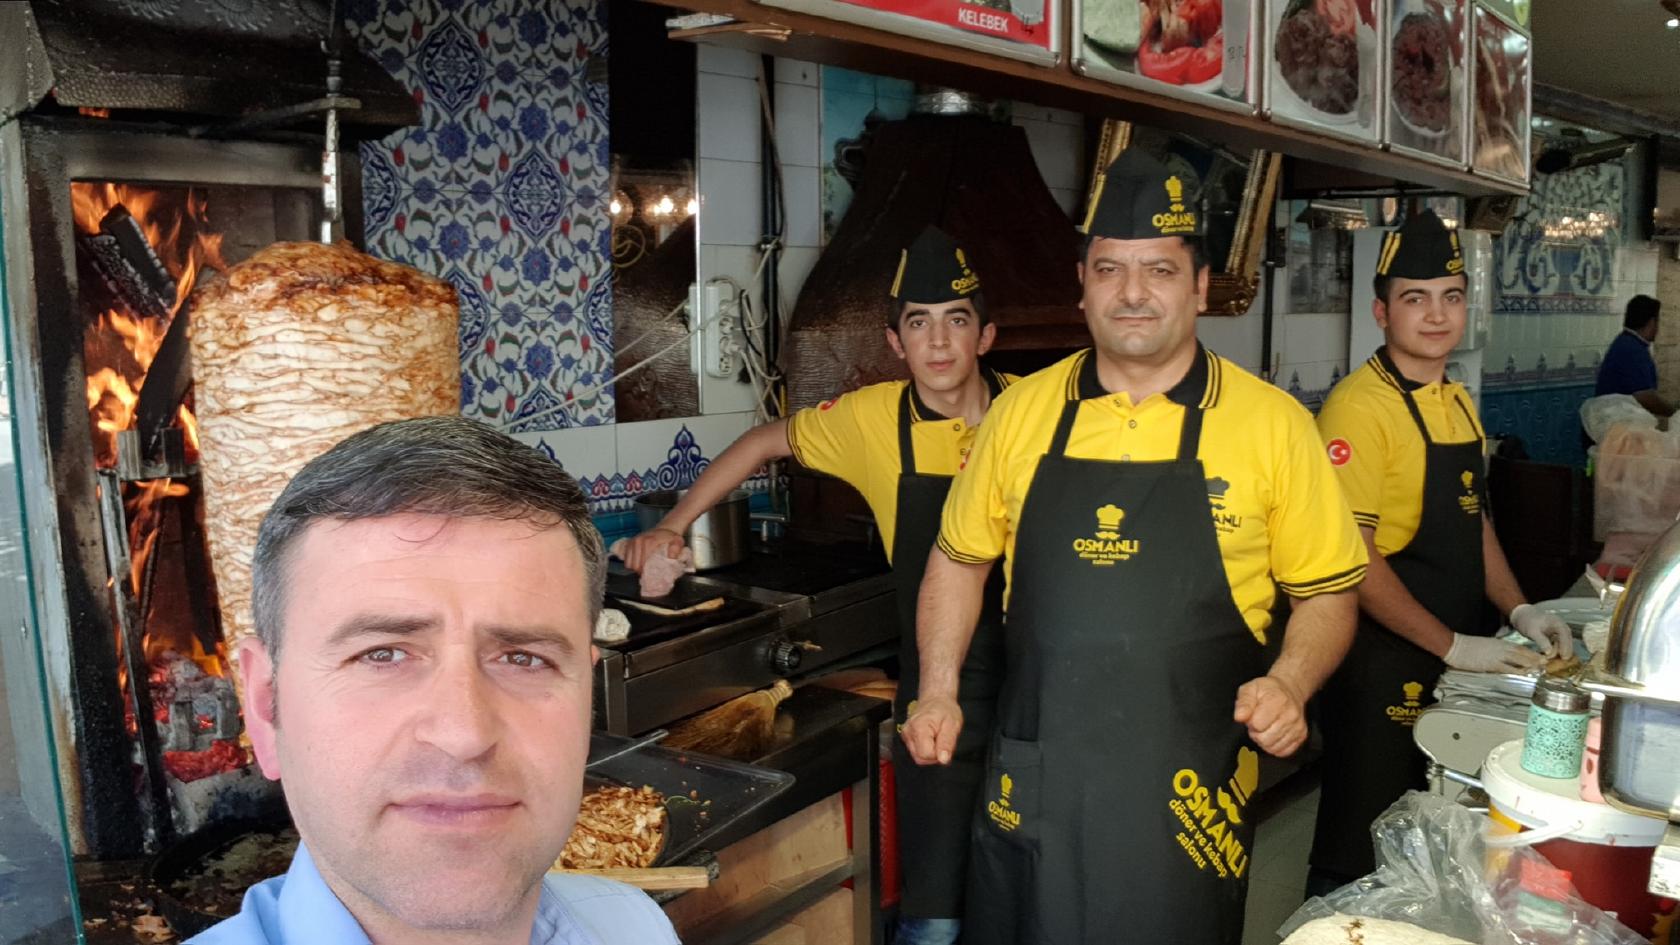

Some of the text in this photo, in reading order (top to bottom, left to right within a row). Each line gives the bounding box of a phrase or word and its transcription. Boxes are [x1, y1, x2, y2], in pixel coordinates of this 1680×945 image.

[958, 7, 1009, 33] KELEBEK
[1073, 538, 1139, 553] OSMANLI
[1168, 799, 1228, 878] döner ve kebap
[1173, 769, 1248, 878] OSMANLI
[1176, 832, 1207, 869] salonu
